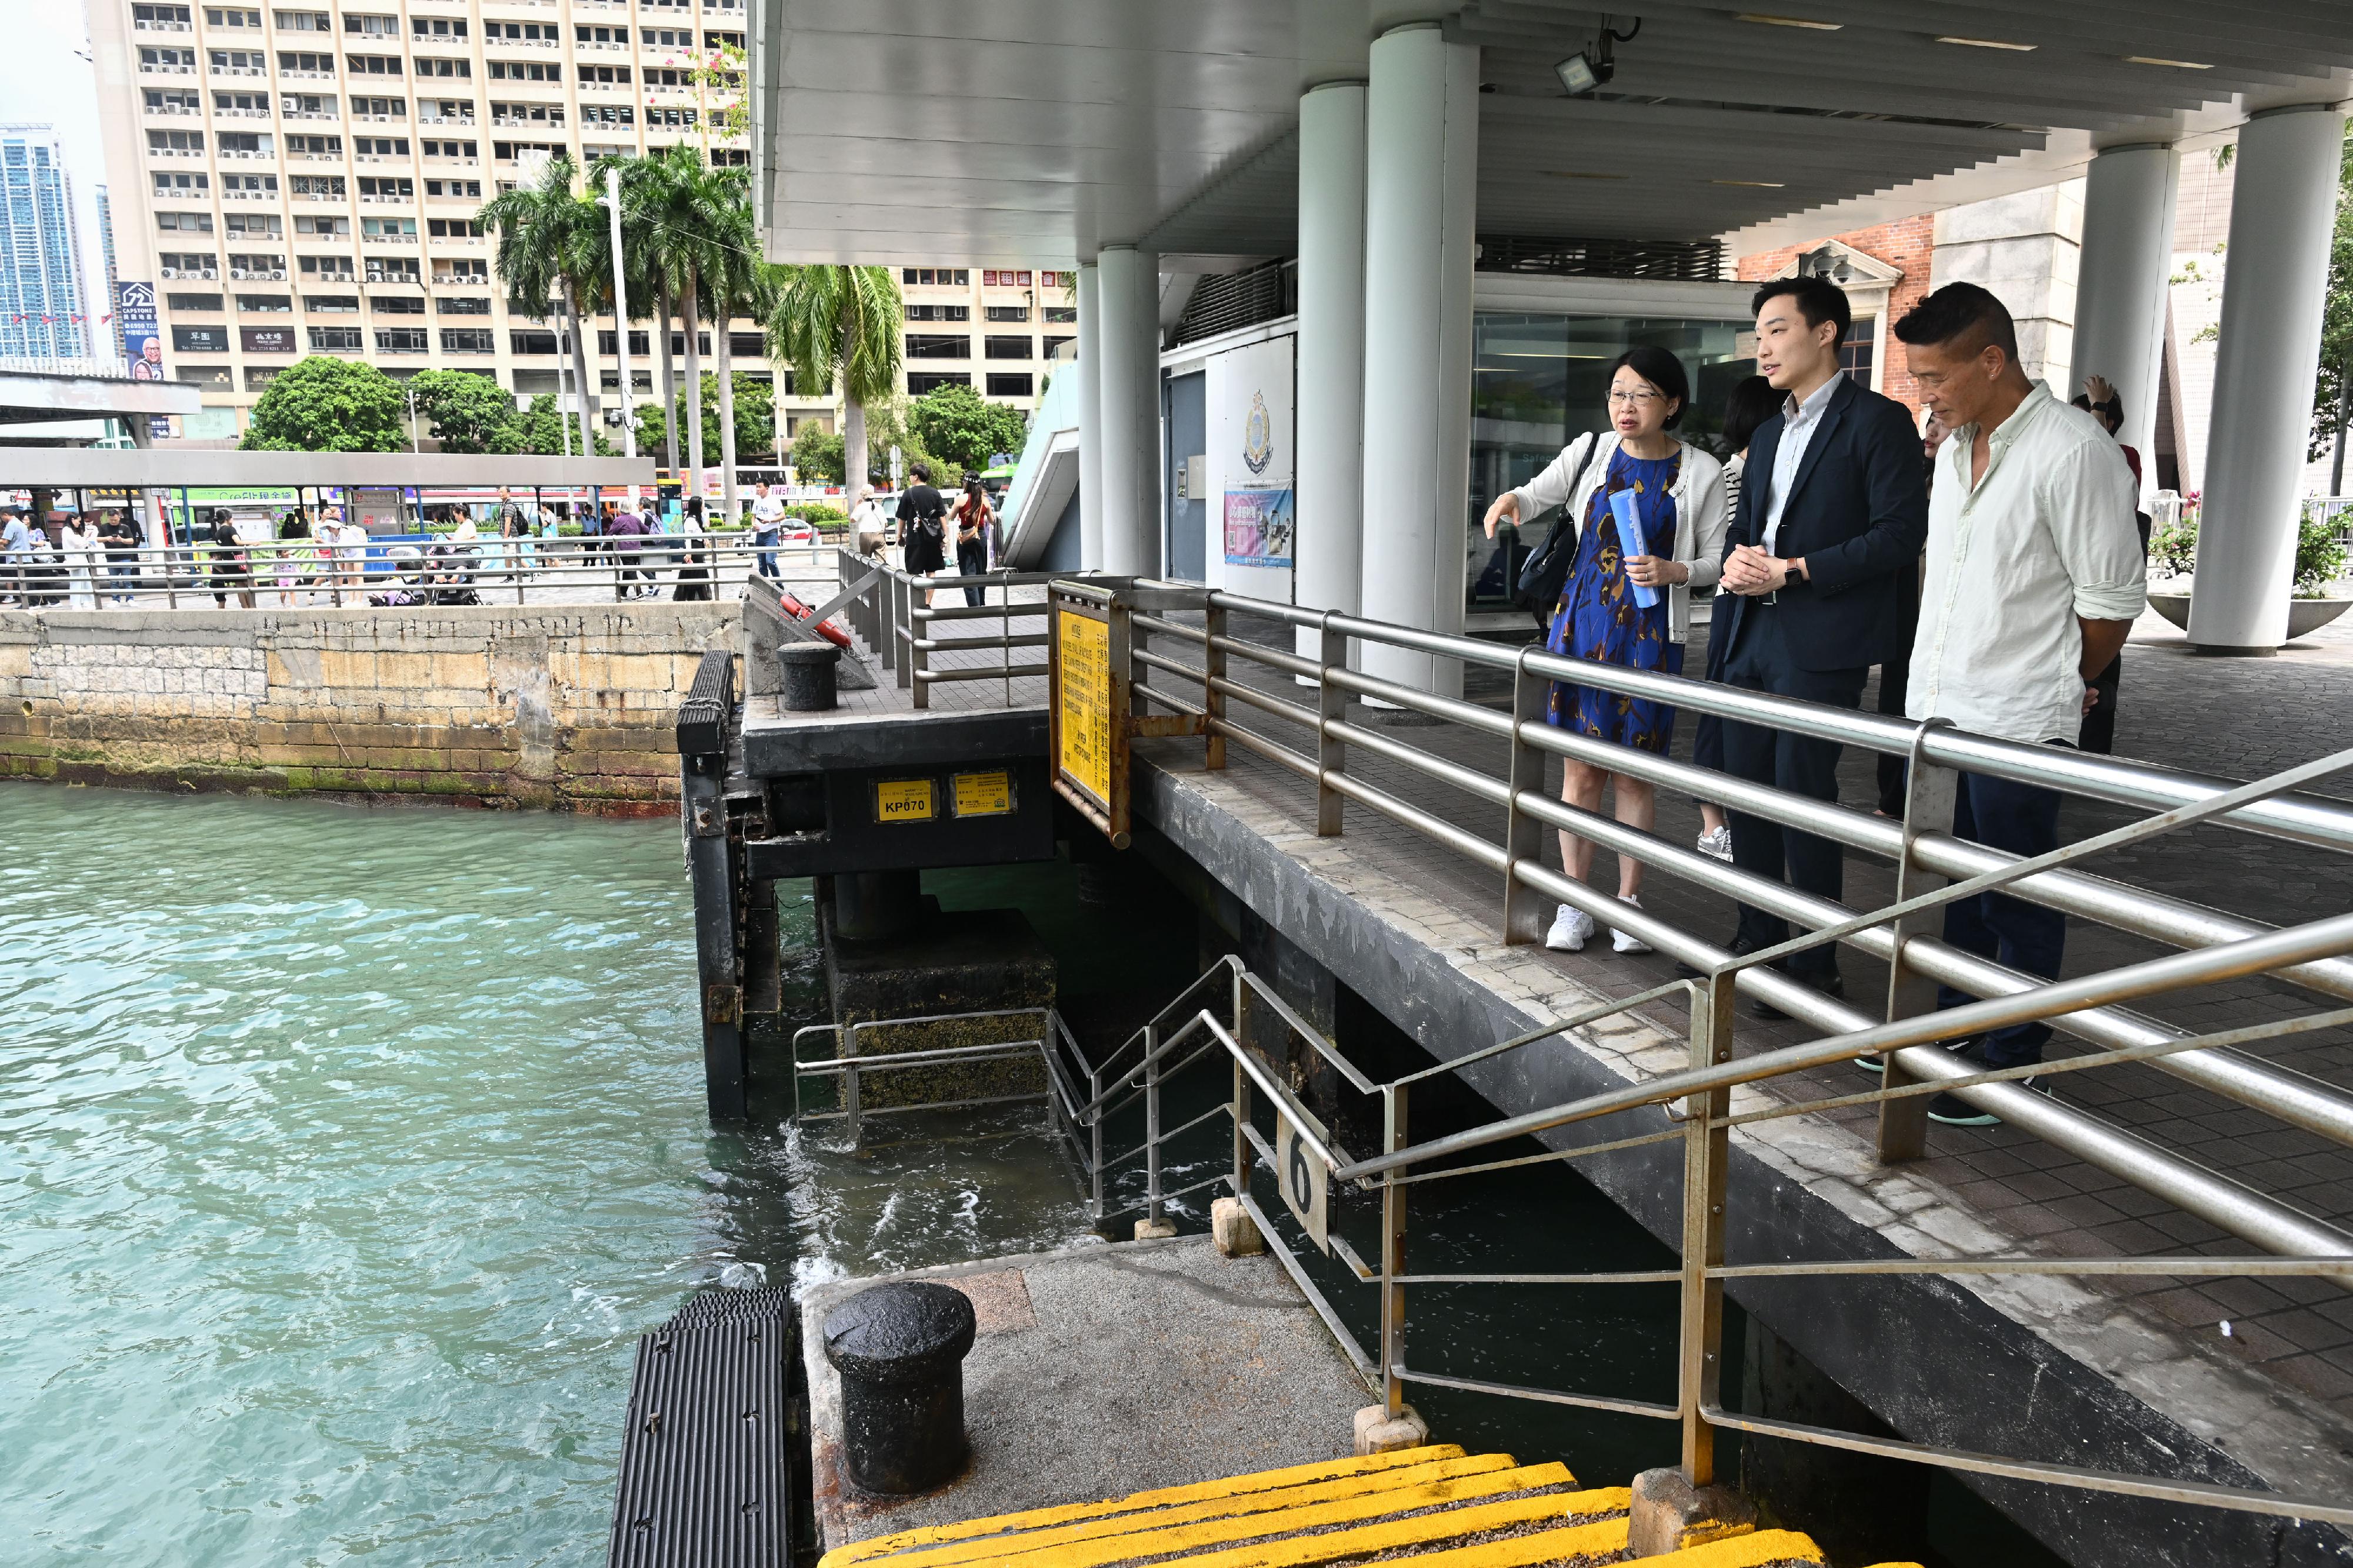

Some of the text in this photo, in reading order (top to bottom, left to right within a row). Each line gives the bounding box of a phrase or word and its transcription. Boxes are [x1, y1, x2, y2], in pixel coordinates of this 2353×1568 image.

[1522, 453, 1554, 465] Safeg
[1072, 624, 1080, 635] NOTICE
[886, 800, 924, 812] KP070
[1291, 1131, 1311, 1215] 6
